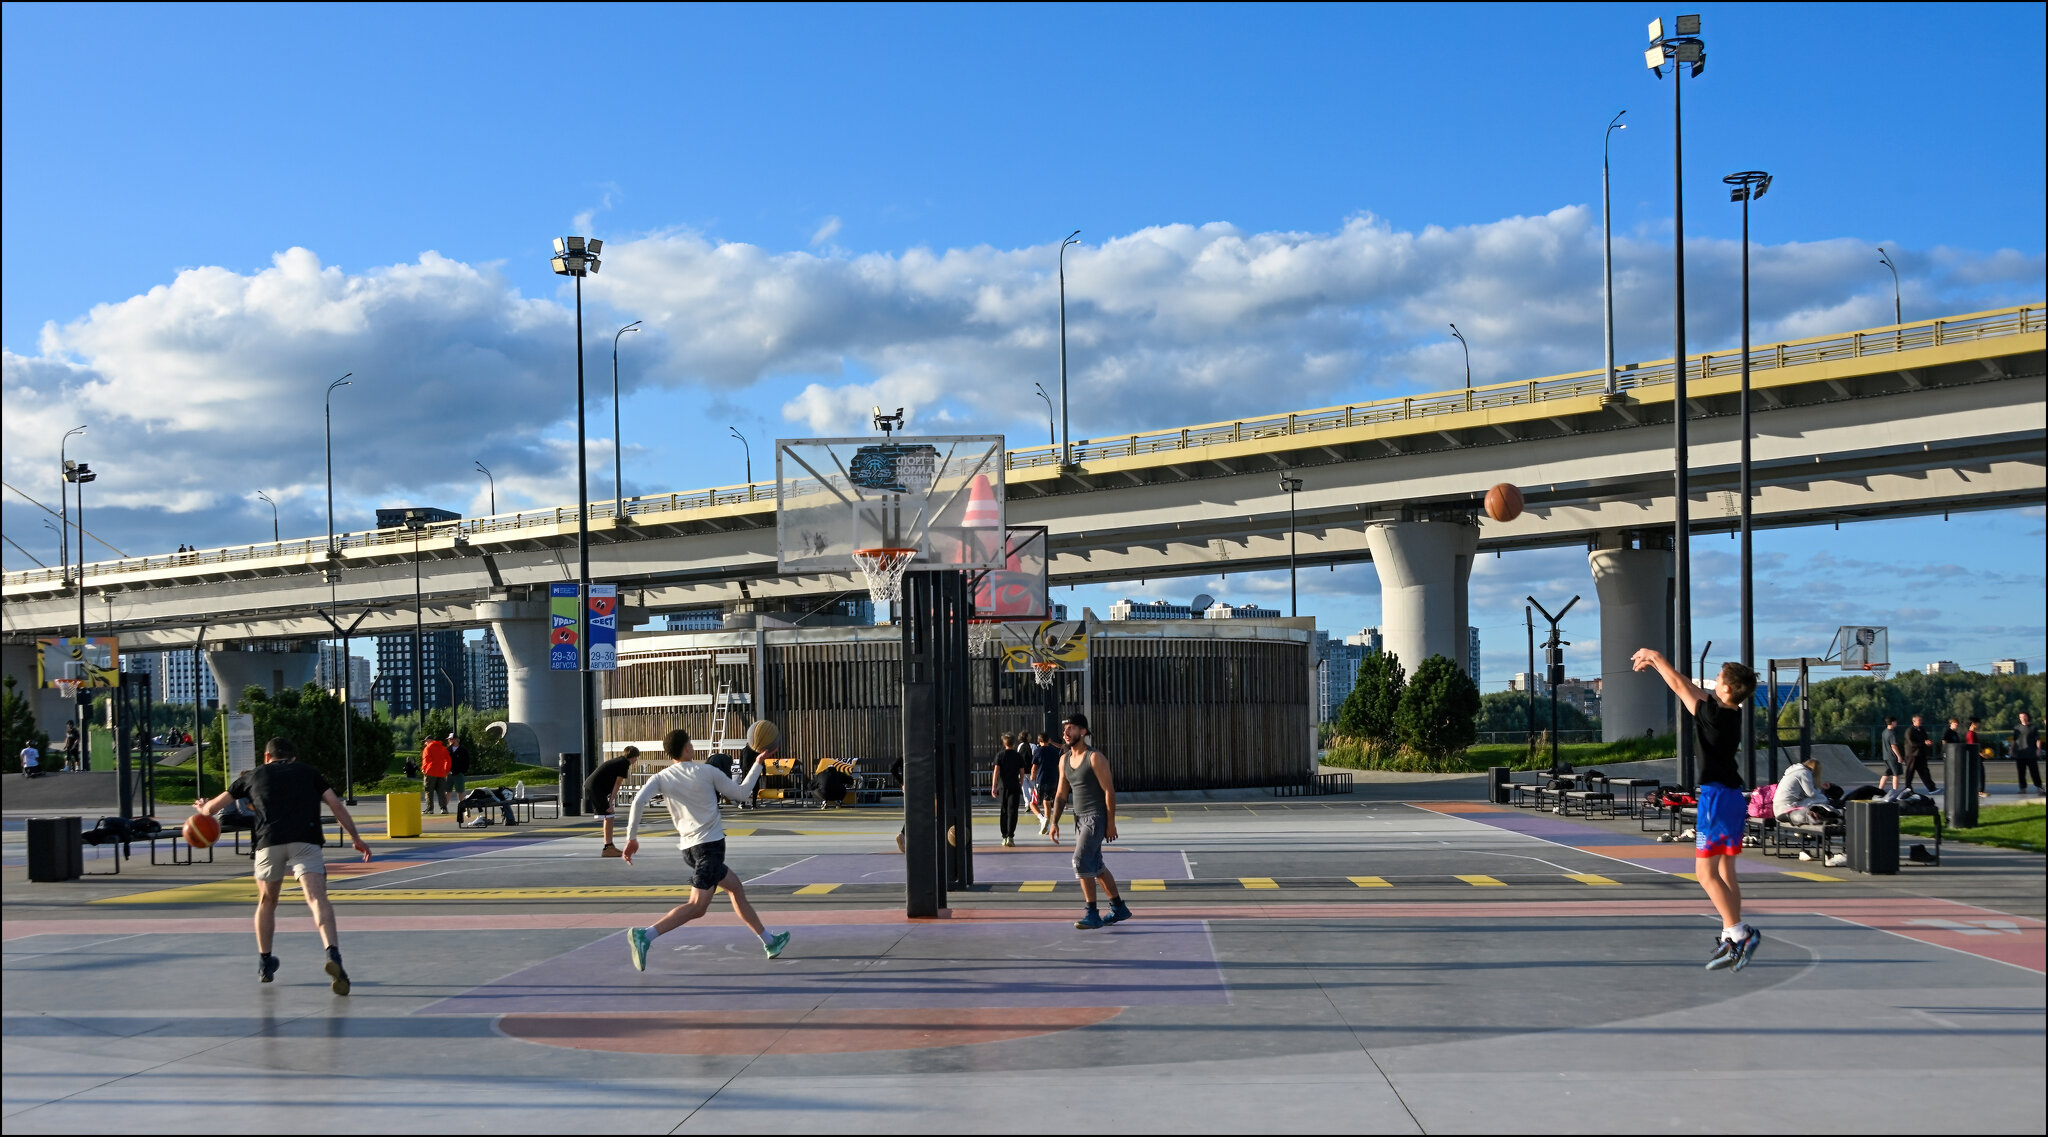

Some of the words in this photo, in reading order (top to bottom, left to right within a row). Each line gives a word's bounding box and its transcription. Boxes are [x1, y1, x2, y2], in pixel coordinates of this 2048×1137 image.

[896, 456, 926, 466] СПОРТ
[896, 466, 934, 475] НОРМА
[897, 475, 931, 484] ЖИЗНИ
[591, 617, 614, 626] ФЕСТ
[552, 651, 577, 661] 29-30
[590, 651, 615, 661] 29-30
[551, 661, 577, 669] АВГУСТА
[590, 661, 616, 669] АВГУСТА
